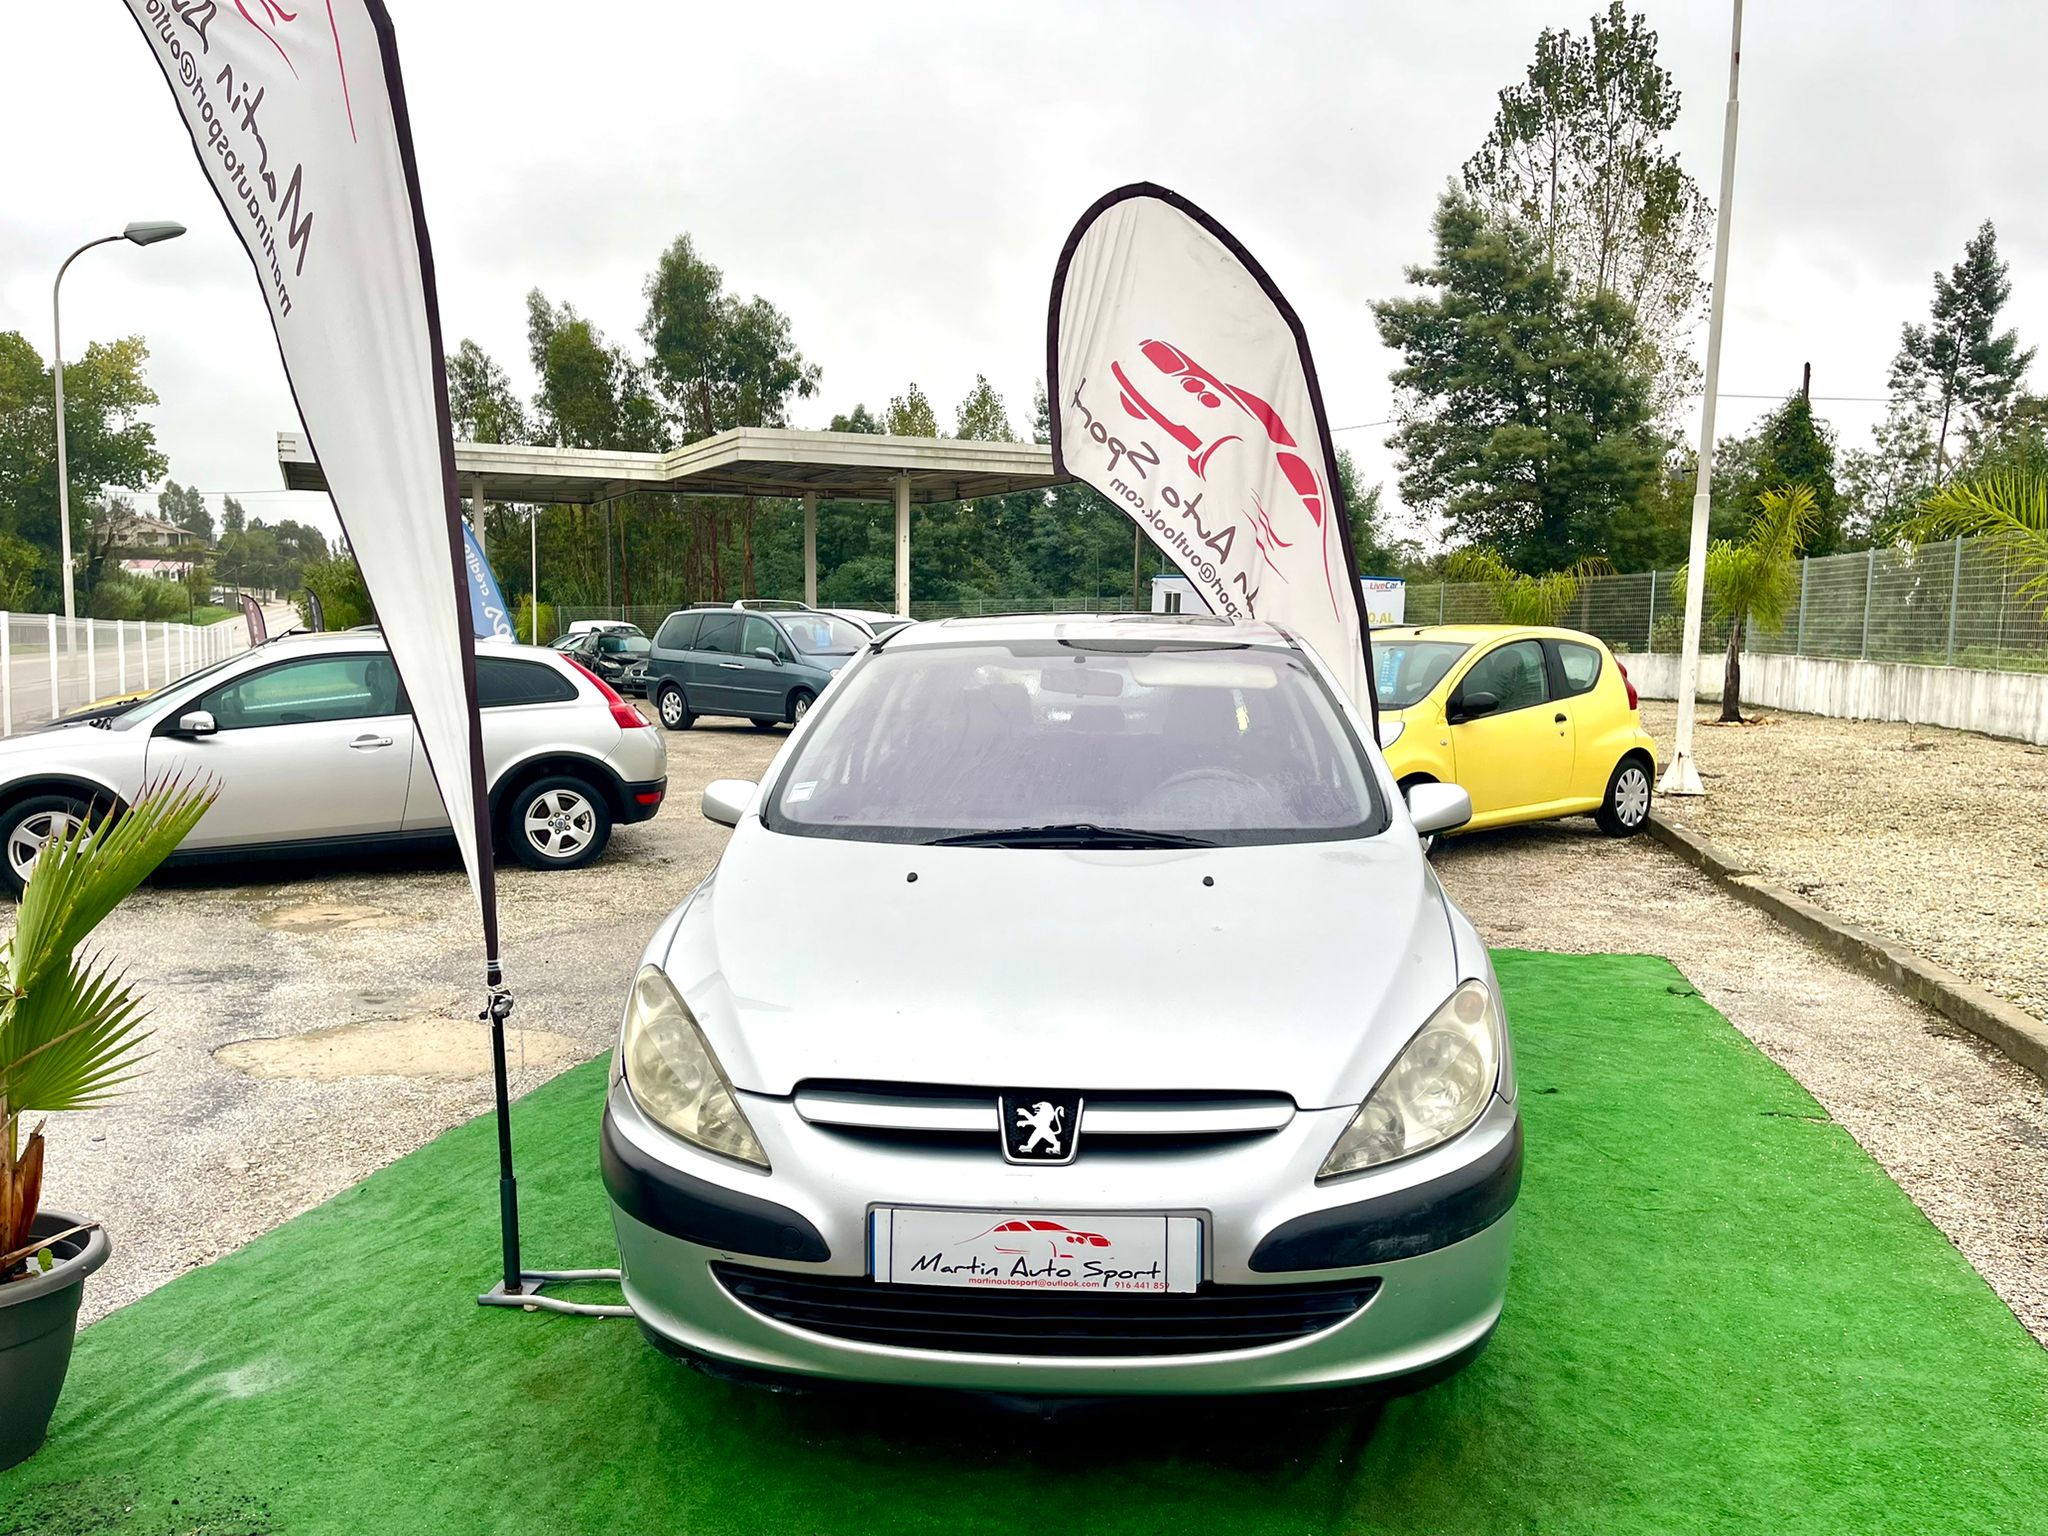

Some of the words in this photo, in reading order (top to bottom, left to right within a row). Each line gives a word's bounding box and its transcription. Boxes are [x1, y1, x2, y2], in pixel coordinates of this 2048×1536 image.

[1370, 582, 1398, 590] LiveCar
[910, 1252, 999, 1277] Martin
[1010, 1256, 1072, 1278] Auto
[1083, 1261, 1161, 1288] Sport
[968, 1276, 1100, 1288] martinautosport@outlook.com
[1114, 1281, 1132, 1289] 916
[1134, 1282, 1150, 1290] 441
